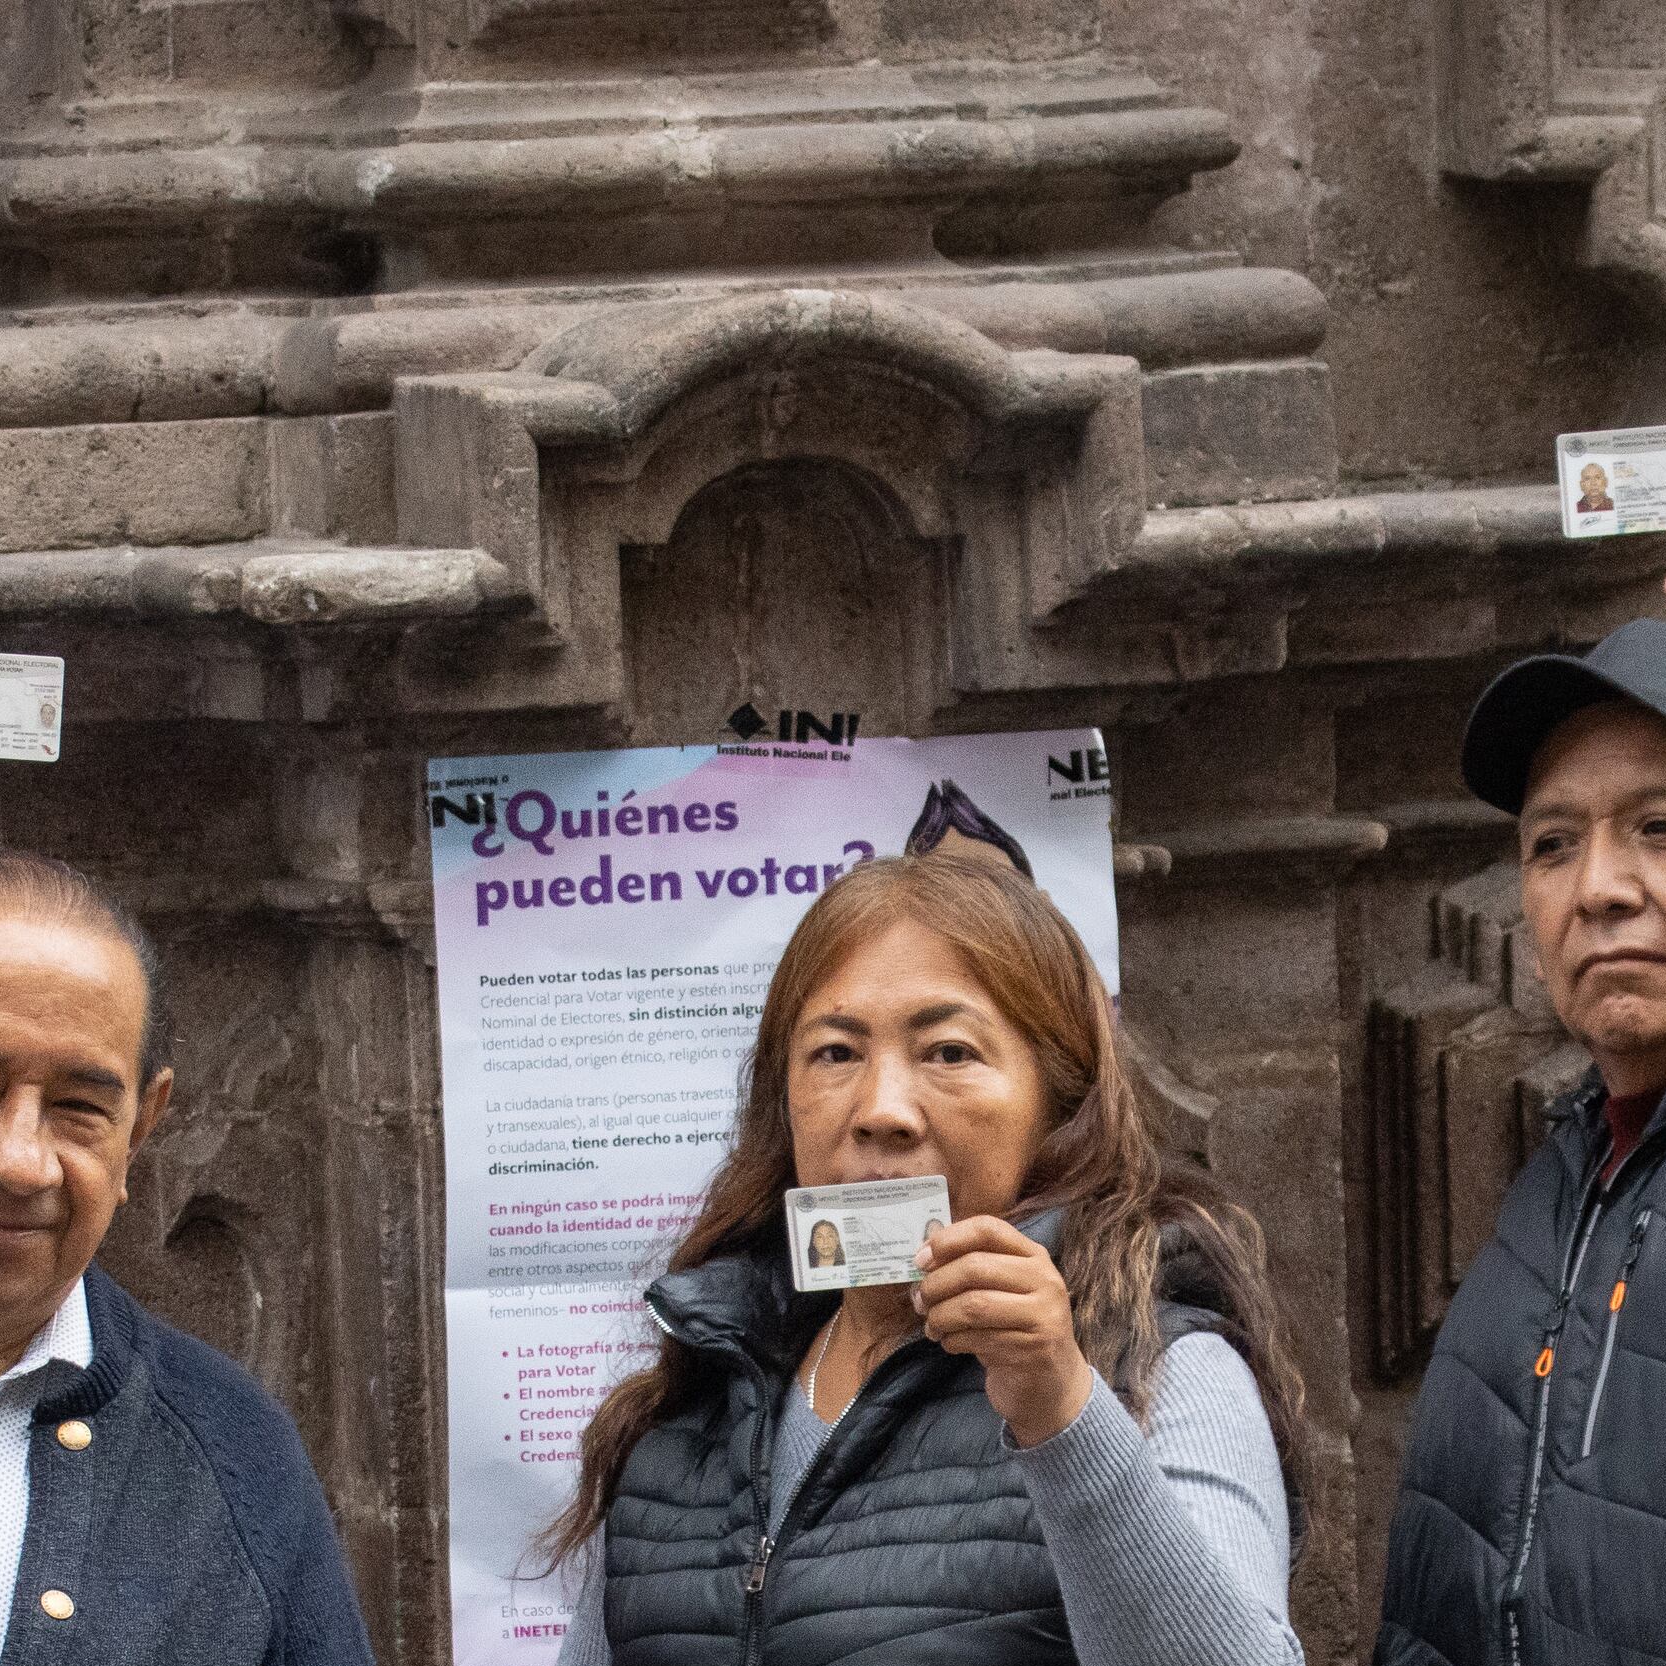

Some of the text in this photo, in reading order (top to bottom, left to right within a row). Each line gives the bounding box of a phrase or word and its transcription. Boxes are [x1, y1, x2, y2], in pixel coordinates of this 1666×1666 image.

[475, 854, 682, 926] pueden
[480, 962, 750, 987] Pueden votar todas las personas que
[480, 984, 727, 1009] Credencial para Votar vigente y estén
[482, 1014, 537, 1029] Nominal
[541, 1014, 557, 1027] de
[561, 1011, 626, 1026] Electores,
[629, 1008, 650, 1022] sin
[654, 1004, 728, 1020] distinción
[483, 1034, 544, 1051] identidad
[548, 1037, 557, 1048] o
[561, 1030, 625, 1048] expresión
[628, 1030, 644, 1043] de
[648, 1028, 698, 1046] género,
[483, 1046, 732, 1073] discapacidad, origen étnico, religión o
[486, 1099, 501, 1113] La
[504, 1095, 573, 1112] ciudadanía
[576, 1094, 610, 1108] trans
[613, 1090, 677, 1109] (personas
[486, 1109, 722, 1138] y transexuales), al igual que cualquier
[487, 1132, 683, 1155] o ciudadana, tiene derecho a
[488, 1157, 599, 1176] discriminación.
[489, 1193, 665, 1217] En ningún caso se podrá
[489, 1215, 653, 1237] cuando la identidad de
[489, 1240, 608, 1257] las modificaciones
[488, 1260, 624, 1278] entre otros aspectos
[489, 1284, 535, 1300] social y
[569, 1303, 588, 1315] no
[517, 1345, 535, 1359] La
[538, 1341, 612, 1360] fotografía
[518, 1365, 597, 1382] para Votar
[519, 1385, 595, 1400] El nombre
[520, 1429, 573, 1442] El sexo
[501, 1604, 554, 1618] En caso
[502, 1628, 509, 1639] a
